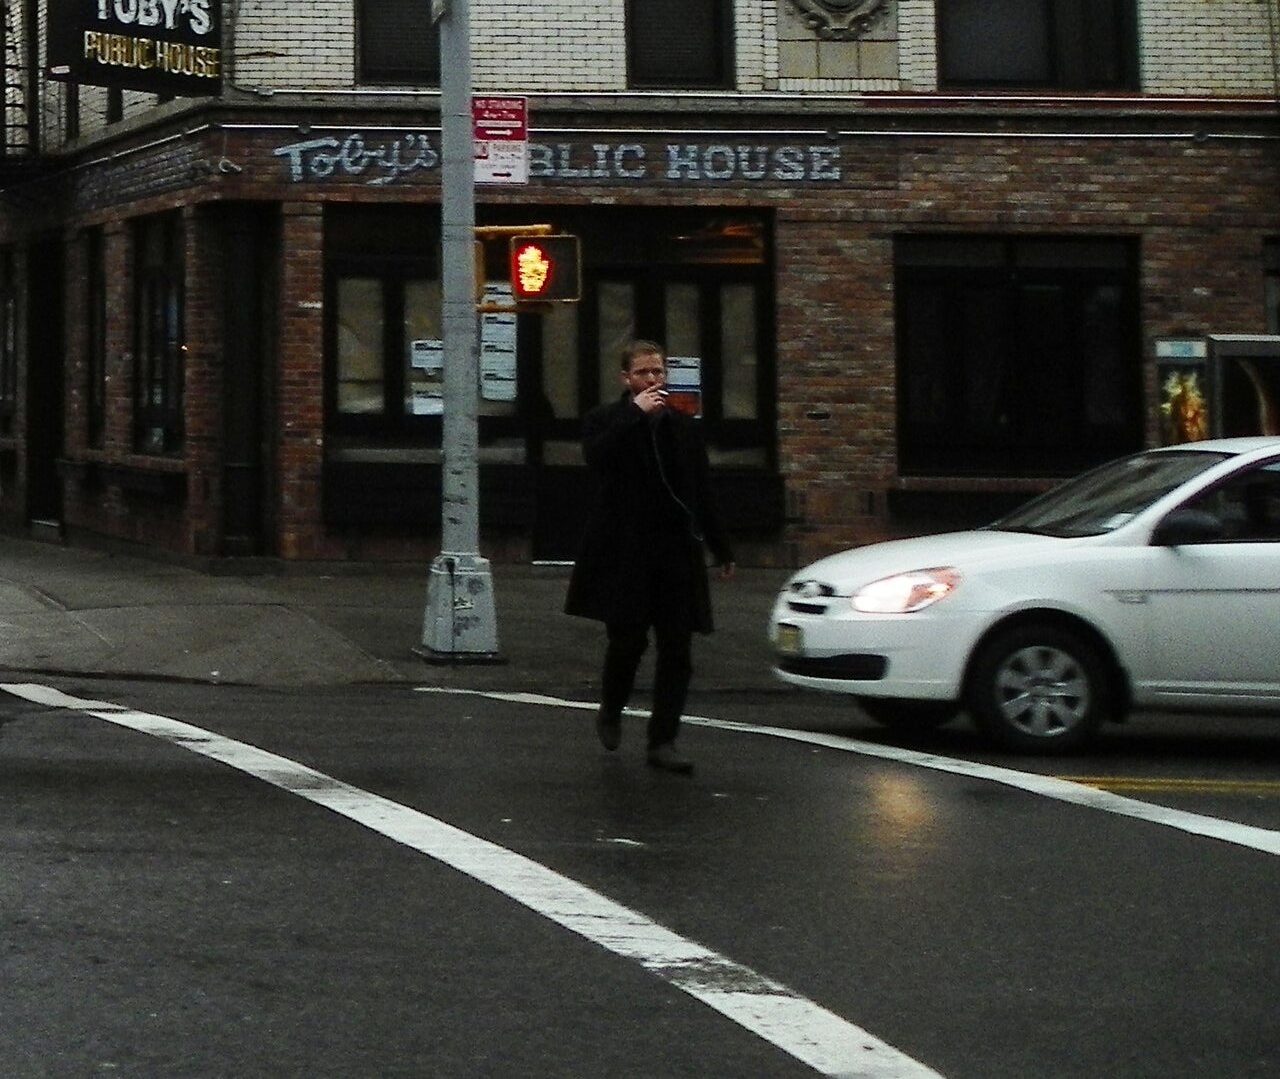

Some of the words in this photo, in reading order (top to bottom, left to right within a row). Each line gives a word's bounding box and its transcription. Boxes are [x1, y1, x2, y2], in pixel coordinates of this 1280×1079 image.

[84, 31, 153, 69] PUBLIC
[156, 40, 220, 78] HOUSE
[274, 132, 438, 186] Toby's
[528, 144, 646, 179] BLIC
[665, 144, 841, 181] HOUSE
